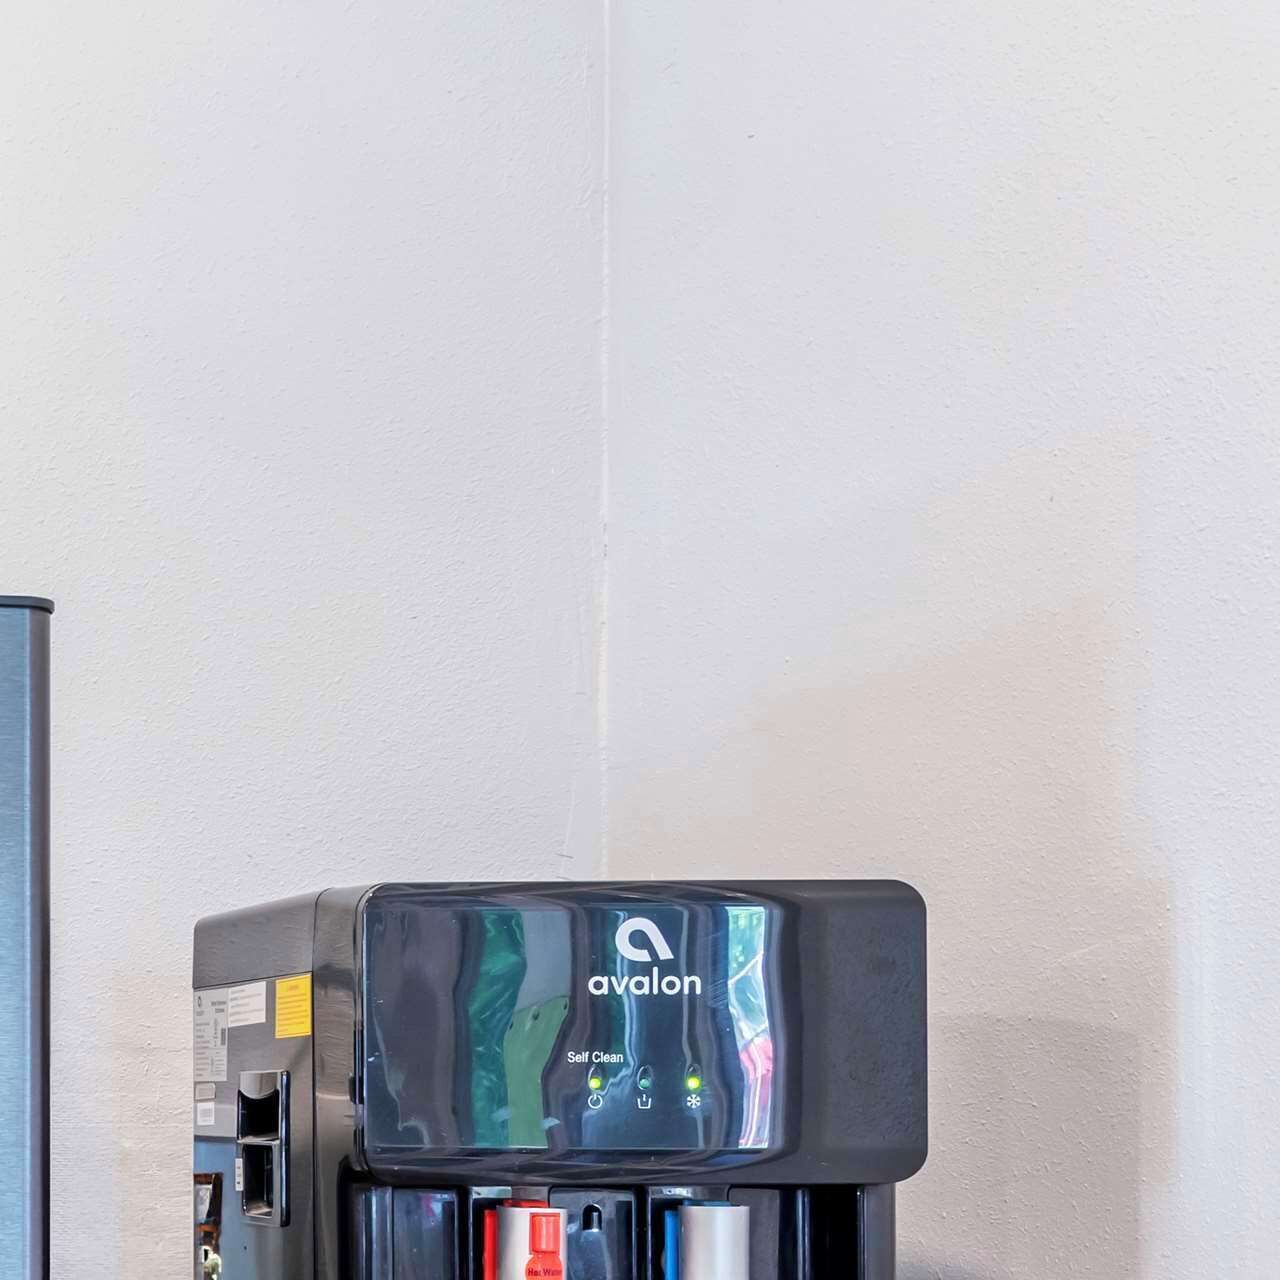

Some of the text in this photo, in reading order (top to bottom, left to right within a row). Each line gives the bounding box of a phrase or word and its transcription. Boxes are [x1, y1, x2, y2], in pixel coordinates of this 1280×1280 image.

[588, 966, 702, 995] avalon
[567, 1051, 624, 1063] Self Clean
